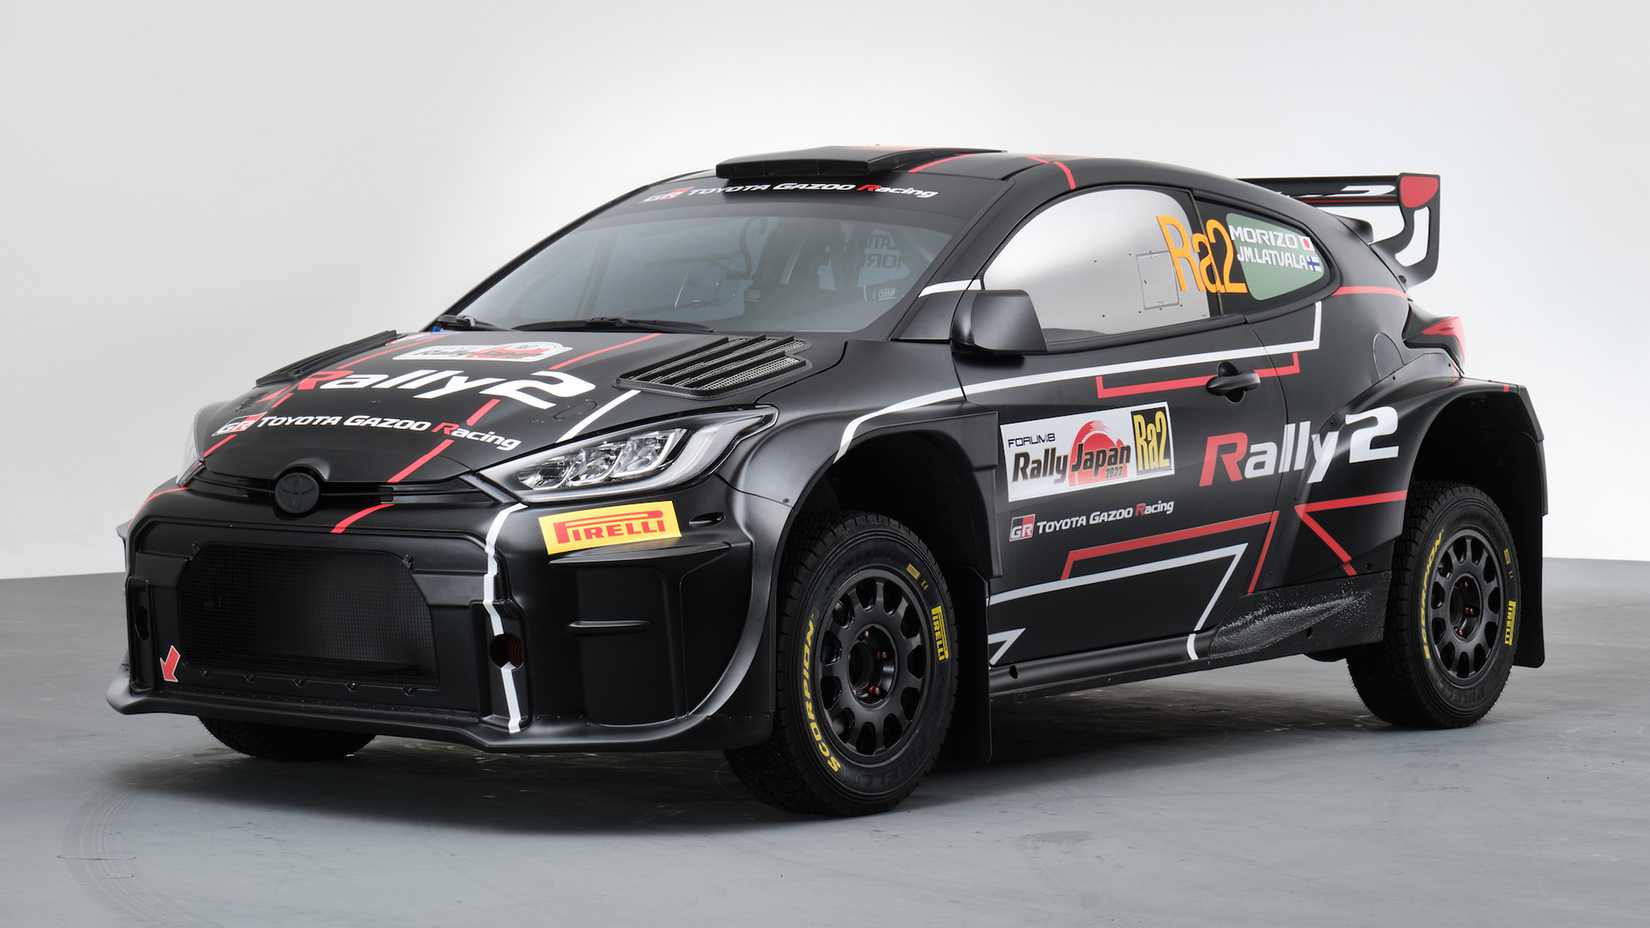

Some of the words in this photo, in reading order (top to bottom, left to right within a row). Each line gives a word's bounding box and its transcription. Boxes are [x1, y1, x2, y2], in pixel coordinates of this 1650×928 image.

[688, 184, 771, 196] TOYOTA
[773, 182, 856, 191] GAZOO
[857, 183, 940, 198] Racing
[1155, 215, 1248, 294] Ra2
[1228, 224, 1299, 249] MORIZO
[214, 415, 263, 435] GR
[257, 415, 343, 428] TOYOTA
[343, 415, 432, 432] GAZOO
[432, 422, 522, 451] Racing
[1007, 432, 1056, 448] FORUM8
[1133, 410, 1171, 471] Ra2
[1012, 446, 1069, 485] Rally
[1071, 443, 1132, 478] Japan
[553, 510, 666, 545] PIRELLI
[1009, 518, 1035, 541] GR
[1037, 515, 1087, 534] TOYOTA
[1089, 506, 1133, 525] GAZOO
[1135, 500, 1175, 517] Racing
[802, 620, 842, 774] SCORPION
